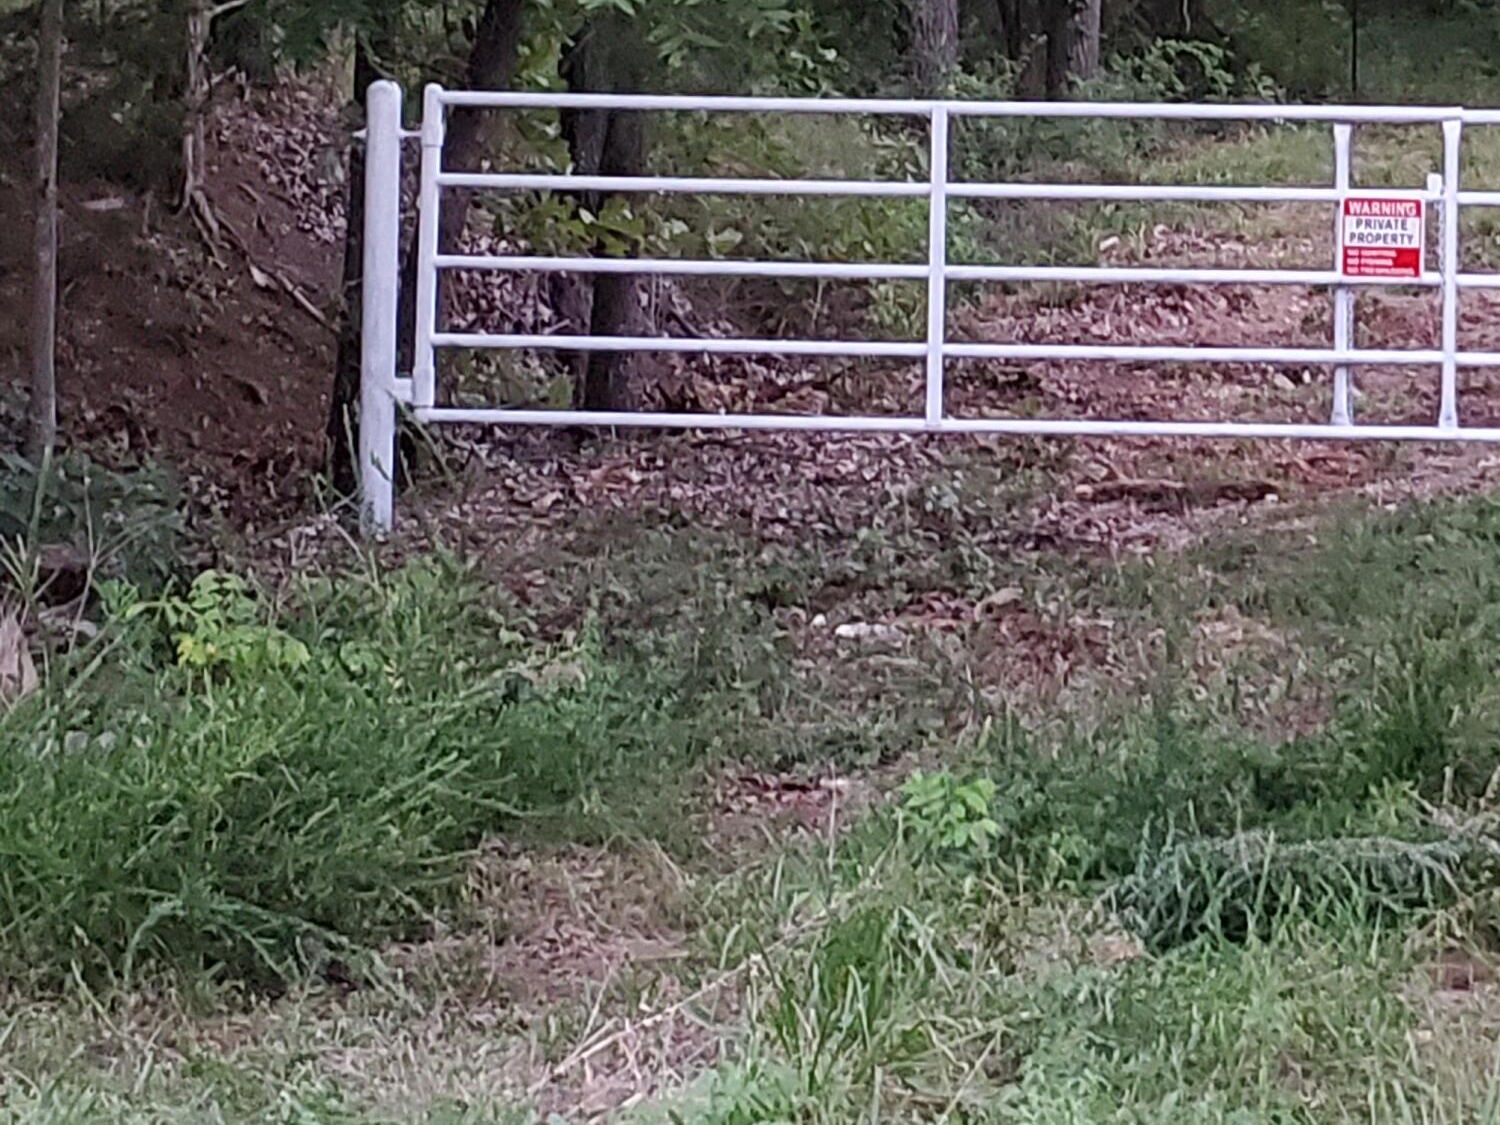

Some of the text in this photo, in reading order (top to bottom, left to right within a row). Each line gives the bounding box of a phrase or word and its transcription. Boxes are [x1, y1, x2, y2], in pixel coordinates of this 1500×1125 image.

[1348, 201, 1417, 216] WARNING
[1355, 218, 1408, 230] PRIVATE
[1349, 232, 1414, 245] PROPERTY
